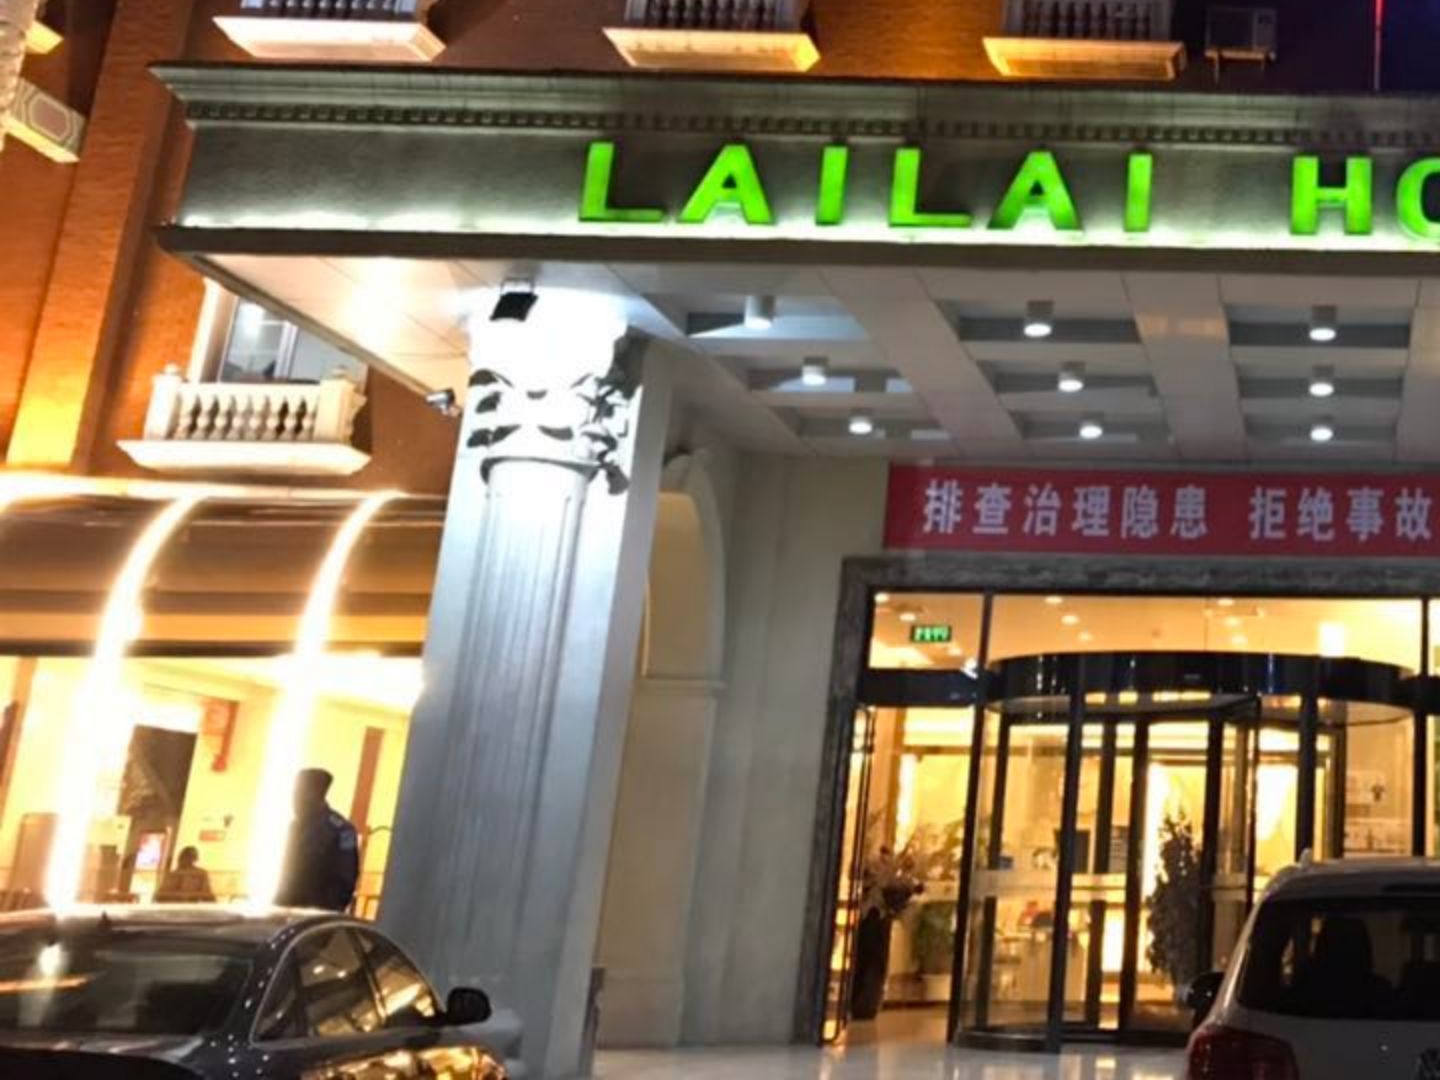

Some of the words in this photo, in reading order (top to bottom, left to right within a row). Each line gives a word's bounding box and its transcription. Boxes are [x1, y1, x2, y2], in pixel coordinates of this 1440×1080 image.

[578, 141, 1153, 233] LAILAI
[922, 479, 1208, 540] 排查治理隐患
